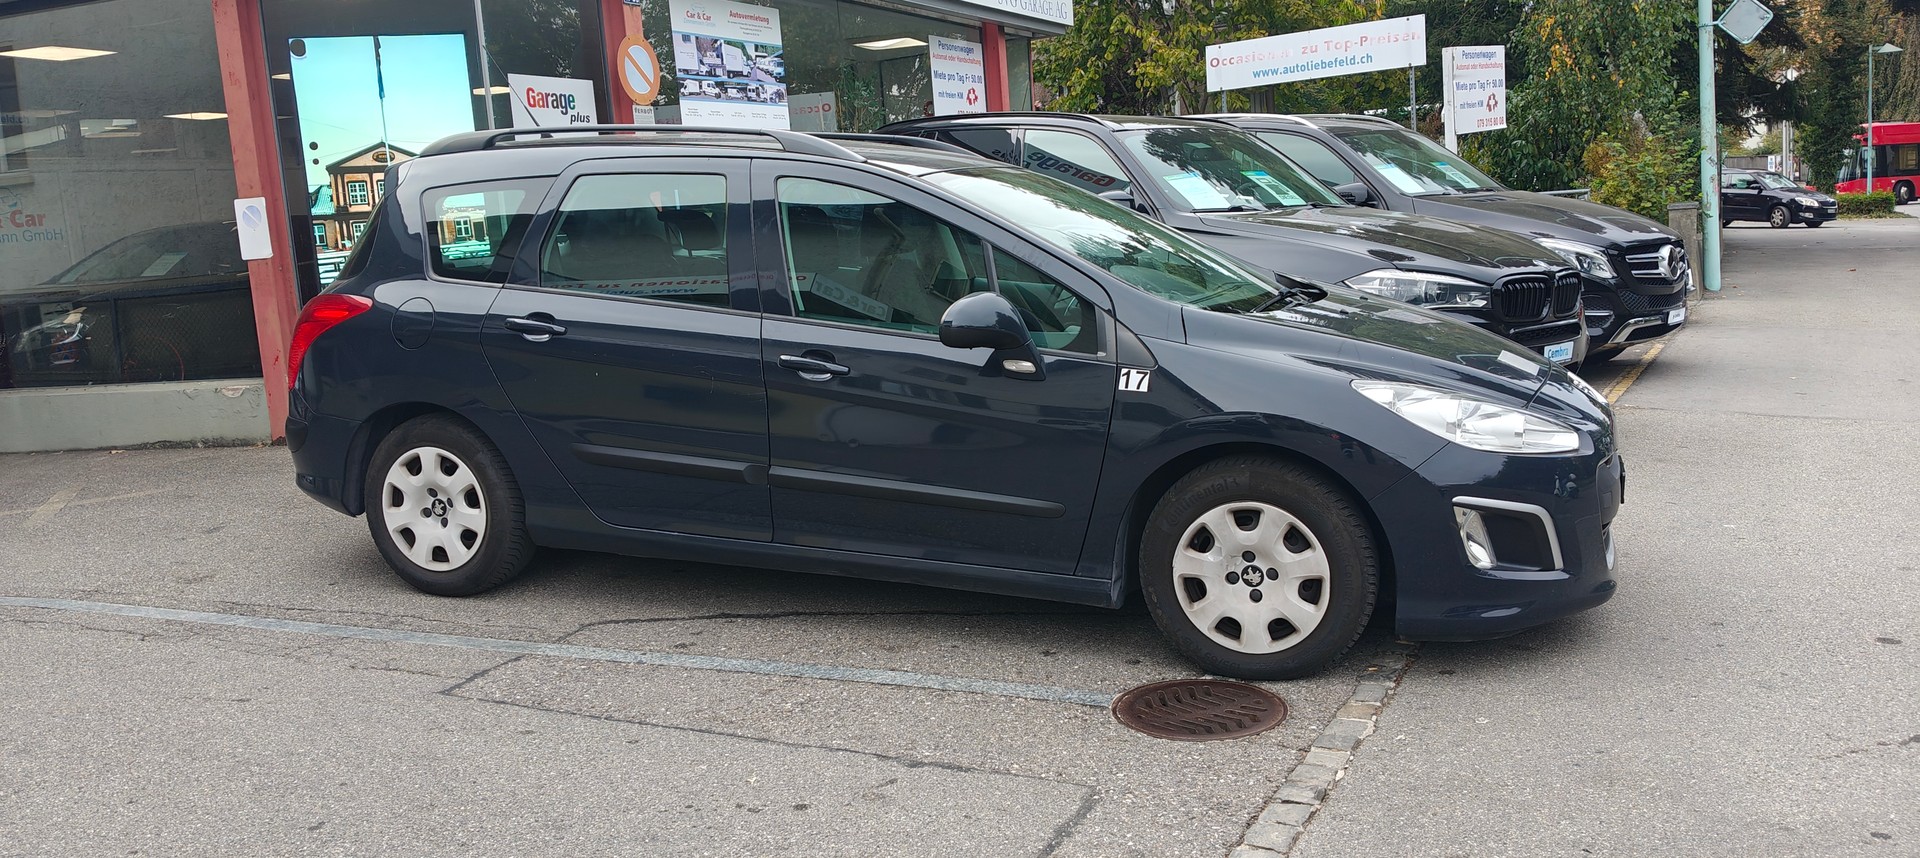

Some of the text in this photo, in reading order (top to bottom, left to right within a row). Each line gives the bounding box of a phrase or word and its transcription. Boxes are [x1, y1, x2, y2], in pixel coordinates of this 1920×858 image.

[686, 10, 695, 19] Car
[702, 13, 712, 21] Car
[1020, 0, 1053, 16] GARAGE
[1056, 1, 1067, 19] AG
[729, 10, 769, 25] Autovermietung
[937, 40, 975, 55] Personenwagen
[1301, 44, 1318, 55] zu
[1461, 50, 1497, 60] Personenwagen
[1252, 53, 1373, 79] www.autoliebefeld.ch
[933, 69, 983, 84] Miete pro Tag Fr 50.00
[1455, 78, 1504, 92] Miete pro Tag Fr 50.00
[526, 87, 576, 115] Garage
[945, 90, 956, 99] freien
[957, 91, 964, 99] KM
[1466, 101, 1477, 109] freien
[570, 111, 591, 125] plus
[10, 209, 46, 228] Car
[0, 228, 63, 243] nn GmbH
[1549, 345, 1569, 358] Cembra
[1121, 369, 1149, 390] 17
